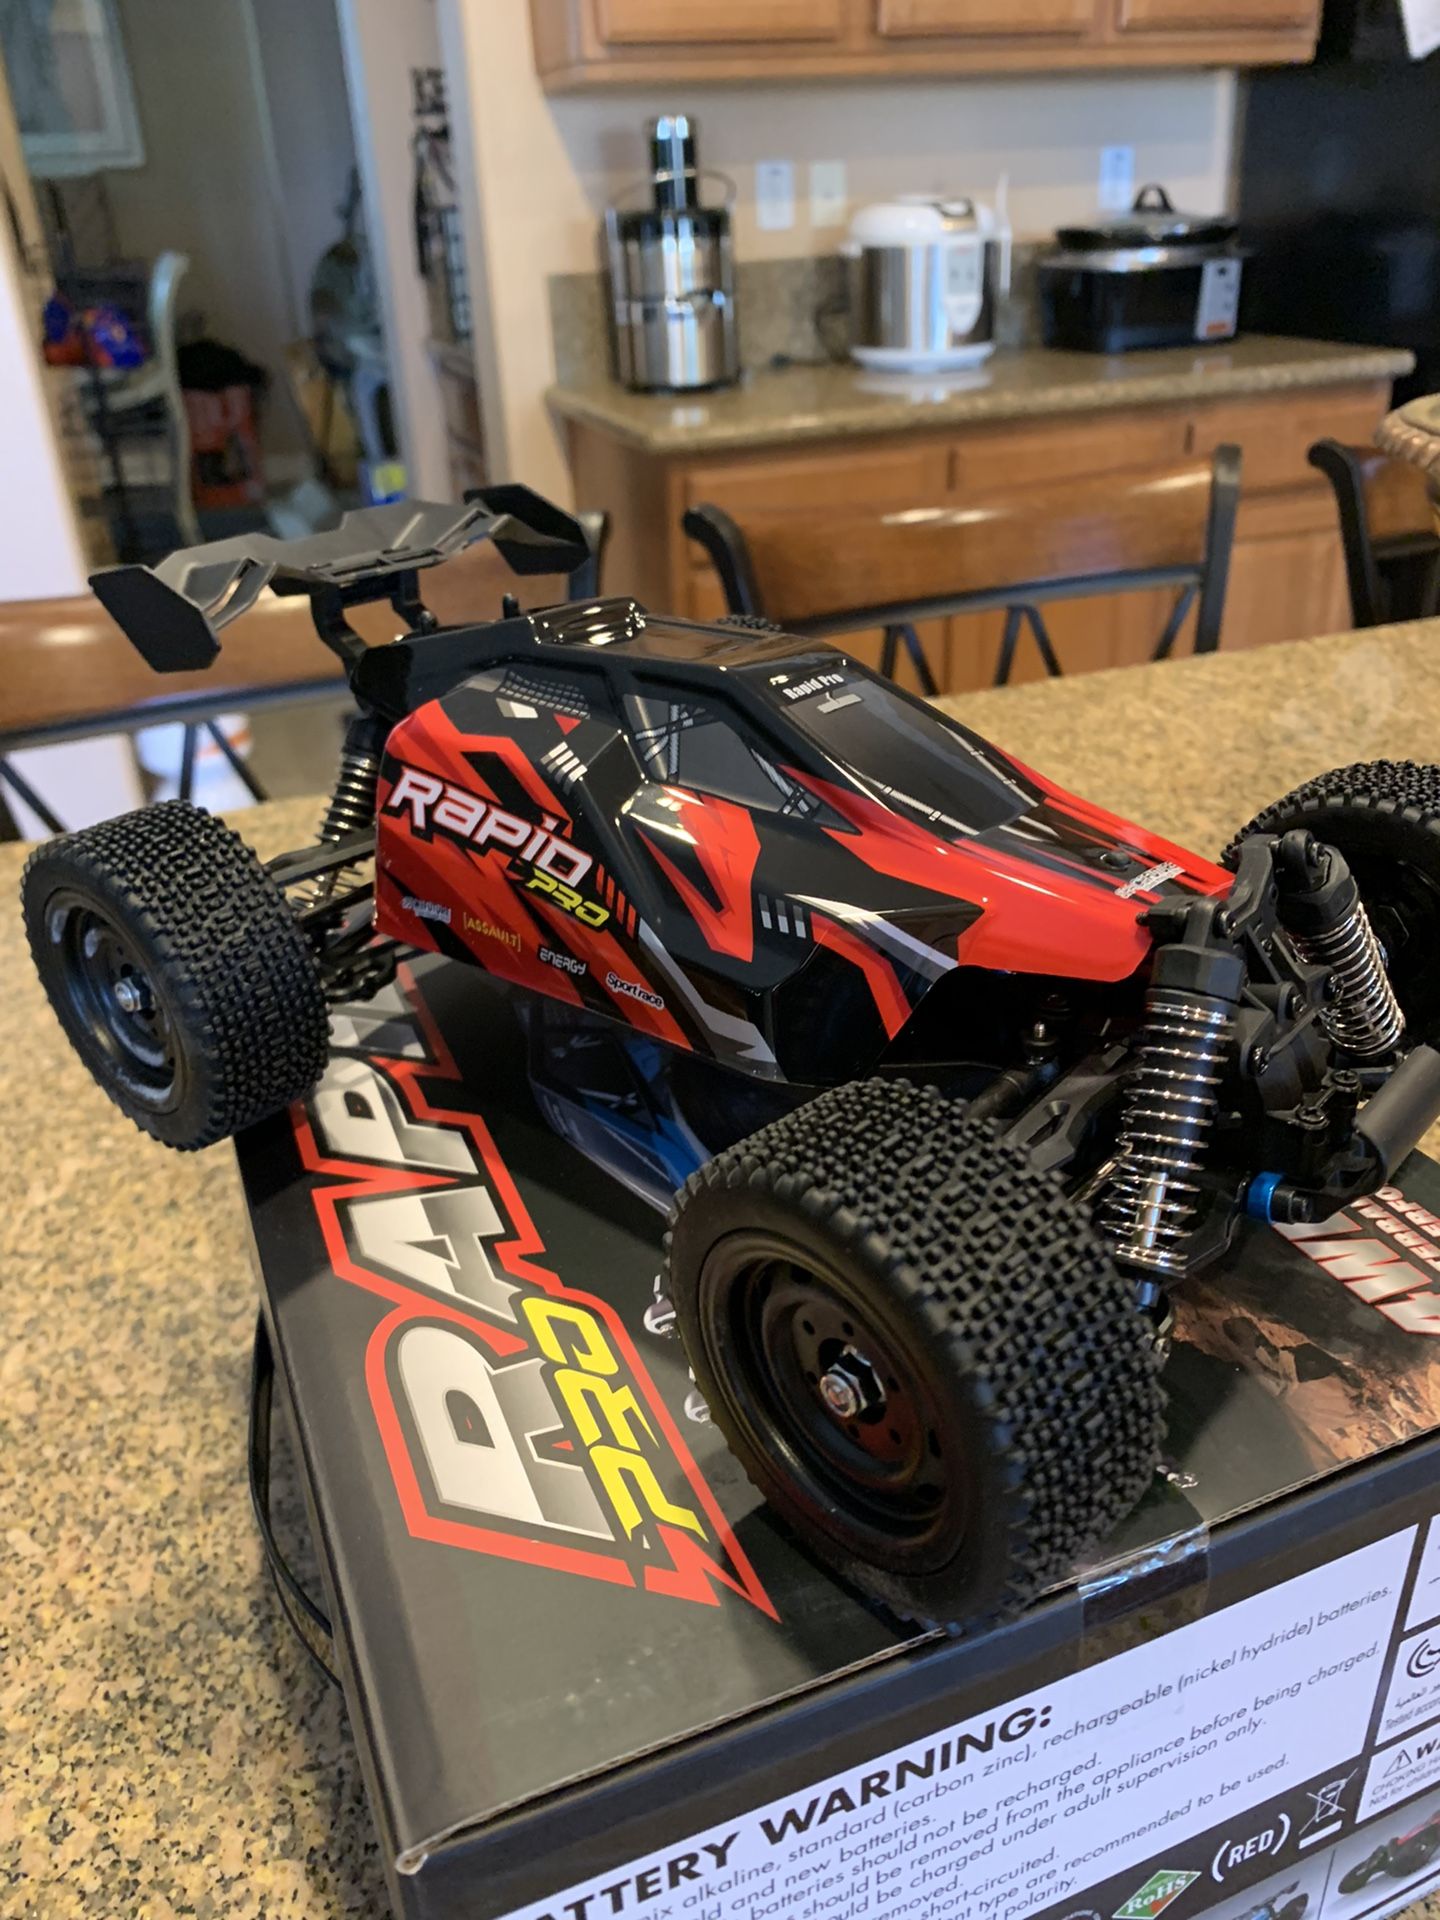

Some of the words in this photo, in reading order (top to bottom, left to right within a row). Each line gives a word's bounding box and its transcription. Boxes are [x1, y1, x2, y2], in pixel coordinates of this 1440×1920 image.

[682, 1861, 782, 1909] alkaline,
[788, 1806, 886, 1863] standard
[893, 1773, 975, 1819] (carbon
[982, 1743, 1038, 1777] zinc),
[1043, 1682, 1173, 1750] rechargeable
[1177, 1650, 1238, 1694] (nickel
[1240, 1615, 1316, 1664] hydride)
[1317, 1586, 1393, 1628] batteries.
[759, 1705, 1053, 1846] WARNING:
[803, 1875, 869, 1919] should
[876, 1867, 902, 1886] be
[910, 1815, 999, 1870] removed
[1004, 1800, 1049, 1827] from
[1057, 1783, 1085, 1803] the
[1092, 1736, 1185, 1789] appliance
[1190, 1707, 1247, 1741] before
[1253, 1680, 1302, 1711] being
[1307, 1642, 1380, 1686] charged.
[877, 1886, 902, 1905] be
[910, 1838, 994, 1889] charged
[1001, 1812, 1058, 1847] under
[1064, 1785, 1112, 1819] adult
[1117, 1738, 1218, 1794] supervision
[1225, 1715, 1268, 1742] only.
[731, 1878, 775, 1911] and
[784, 1859, 831, 1888] new
[840, 1816, 936, 1863] batteries.
[750, 1872, 845, 1920] batteries
[852, 1834, 918, 1876] should
[923, 1820, 955, 1845] not
[962, 1807, 988, 1826] be
[996, 1752, 1102, 1812] recharged.
[920, 1846, 1060, 1920] short-circuited.
[979, 1886, 1019, 1914] type
[1025, 1869, 1057, 1890] are
[1063, 1798, 1193, 1873] recommended
[1197, 1793, 1214, 1808] to
[1219, 1779, 1242, 1798] be
[1247, 1752, 1290, 1784] used.
[1004, 1876, 1078, 1920] polarity.
[1124, 1874, 1188, 1914] RoHS
[1211, 1813, 1291, 1882] (RED)
